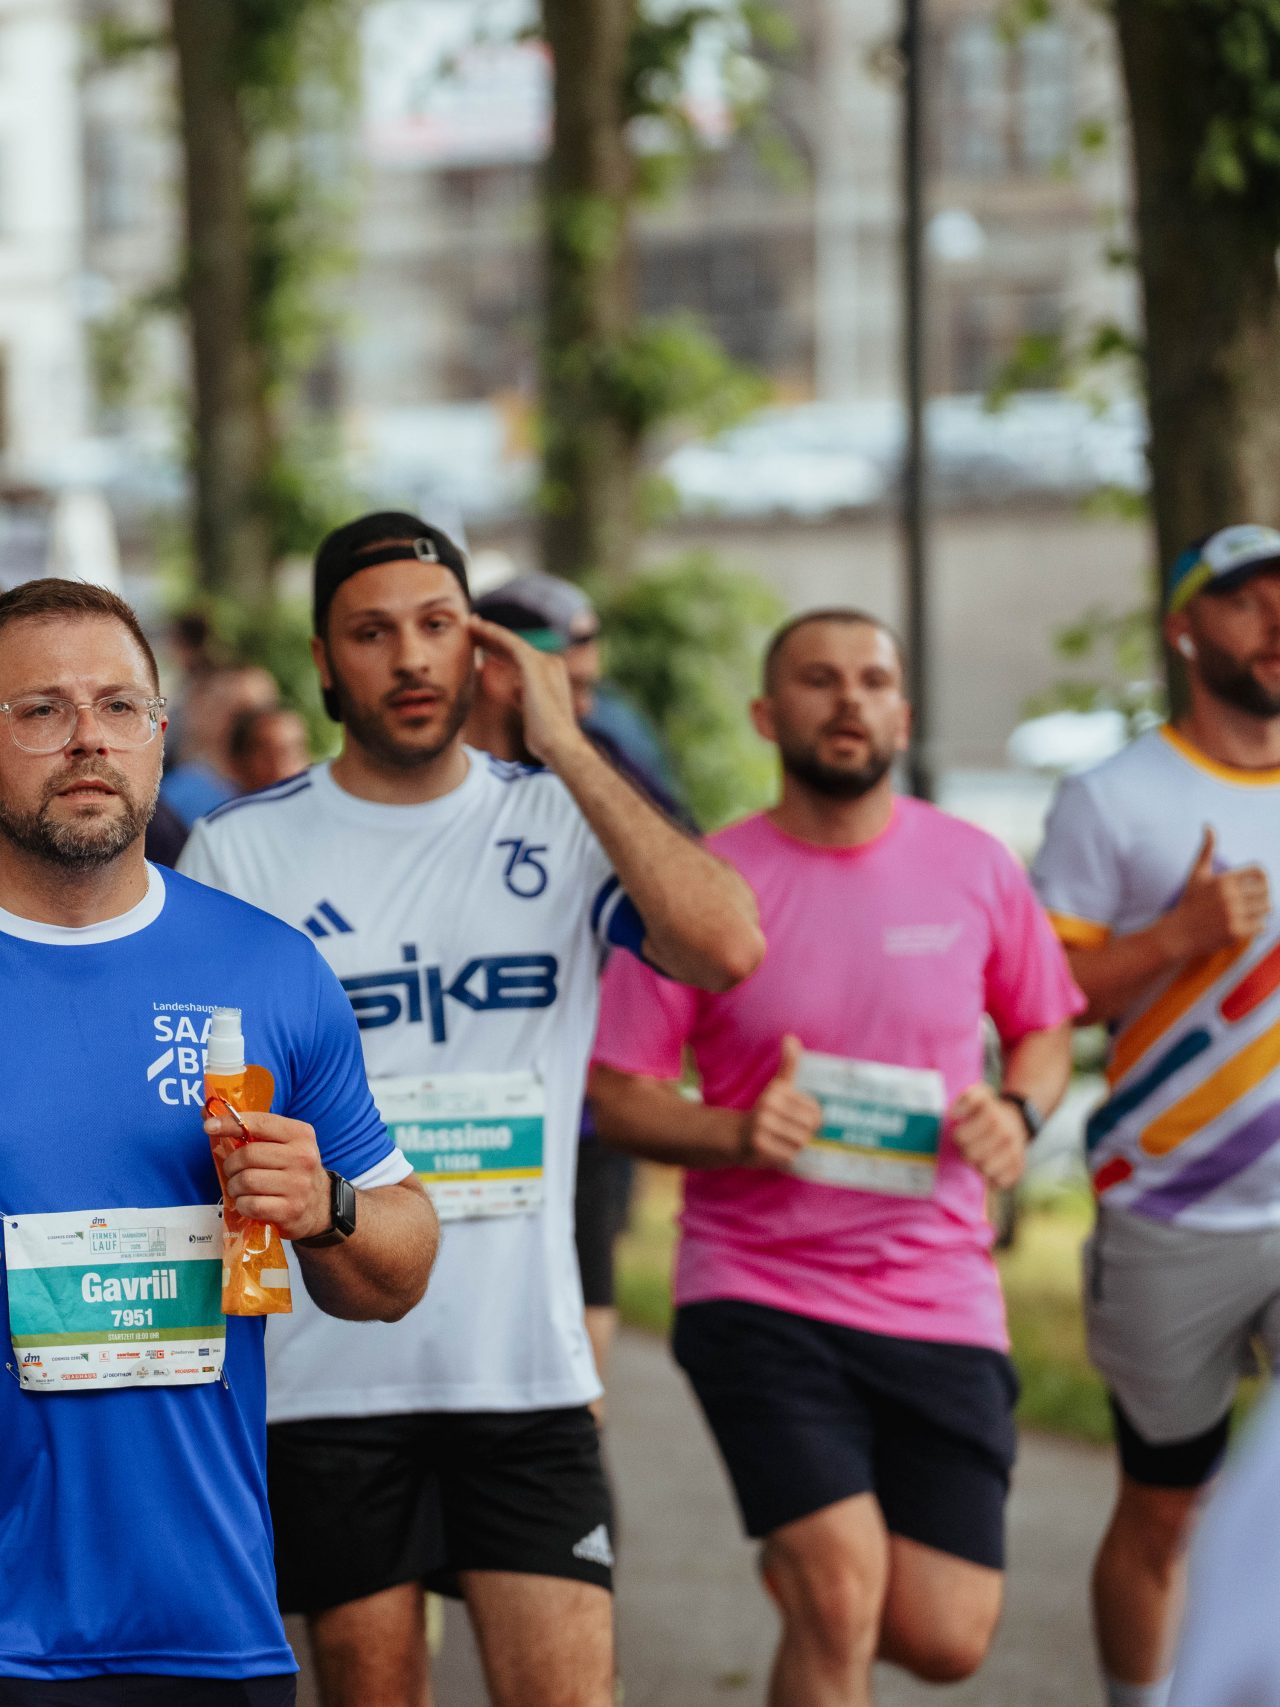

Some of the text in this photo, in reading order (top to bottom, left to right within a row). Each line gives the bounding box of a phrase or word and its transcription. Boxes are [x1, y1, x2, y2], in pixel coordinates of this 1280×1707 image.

[496, 837, 547, 898] 75
[153, 1015, 213, 1044] SAA
[158, 1077, 206, 1106] CK
[394, 1122, 512, 1151] Massimo
[92, 1232, 117, 1240] FIRMEN
[92, 1241, 117, 1251] LAUF
[81, 1269, 177, 1303] Gavriil
[111, 1308, 153, 1327] 7951
[24, 1353, 40, 1362] dm
